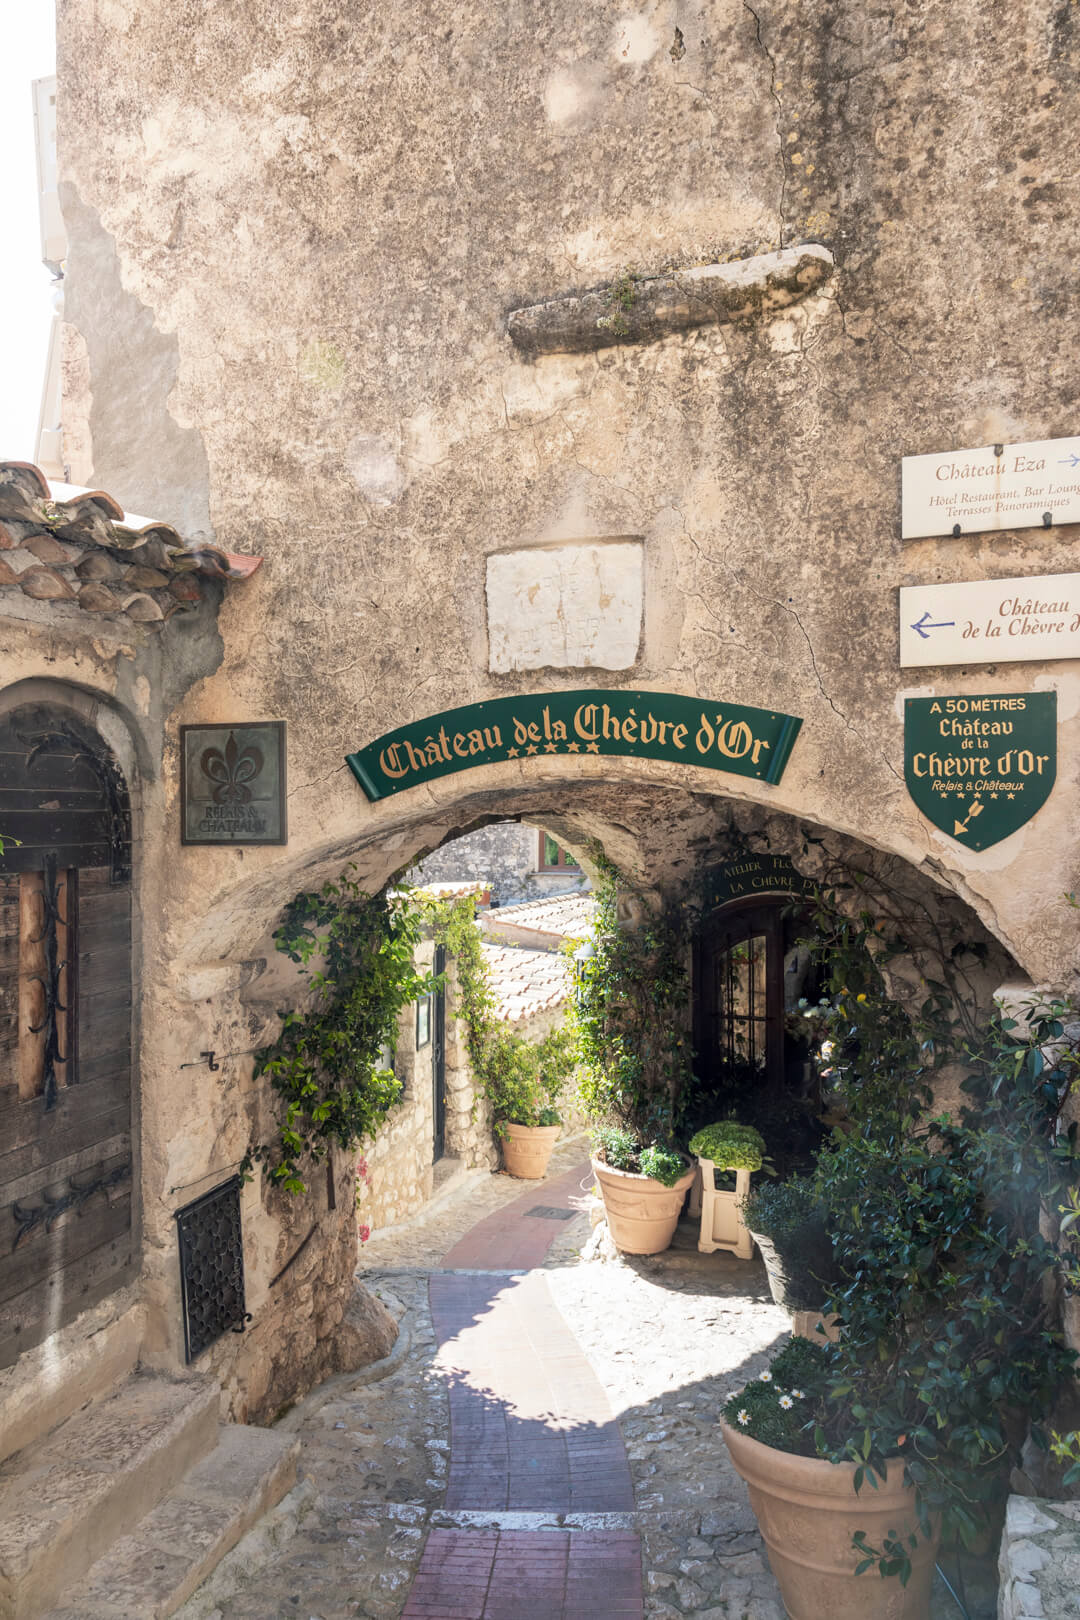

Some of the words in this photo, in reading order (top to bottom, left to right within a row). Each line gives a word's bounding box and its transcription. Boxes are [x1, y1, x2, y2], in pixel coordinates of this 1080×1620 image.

[935, 463, 1005, 481] Château
[1013, 456, 1046, 473] Eza
[929, 493, 957, 506] Hôtel
[1024, 486, 1044, 497] Bar
[1048, 483, 1080, 496] Loung
[946, 506, 992, 517] Terrasses
[996, 498, 1070, 512] Panoramiques
[999, 597, 1070, 616] Château
[962, 620, 980, 639] de
[985, 619, 1001, 637] la
[1008, 617, 1065, 636] Chèvre
[930, 702, 942, 714] A
[946, 700, 968, 713] 50
[939, 718, 1013, 737] Château
[380, 725, 503, 778] Château
[574, 703, 689, 750] Chèvre
[695, 712, 770, 764] d'Or
[961, 738, 974, 749] de
[977, 737, 989, 749] la
[913, 752, 992, 778] Chèvre
[998, 749, 1049, 775] d'Or
[932, 780, 963, 791] Relais
[974, 780, 1024, 791] Châteaux
[205, 806, 244, 818] RELAIS
[248, 806, 258, 818] &
[723, 862, 762, 879] ATELIER
[729, 882, 744, 894] LA
